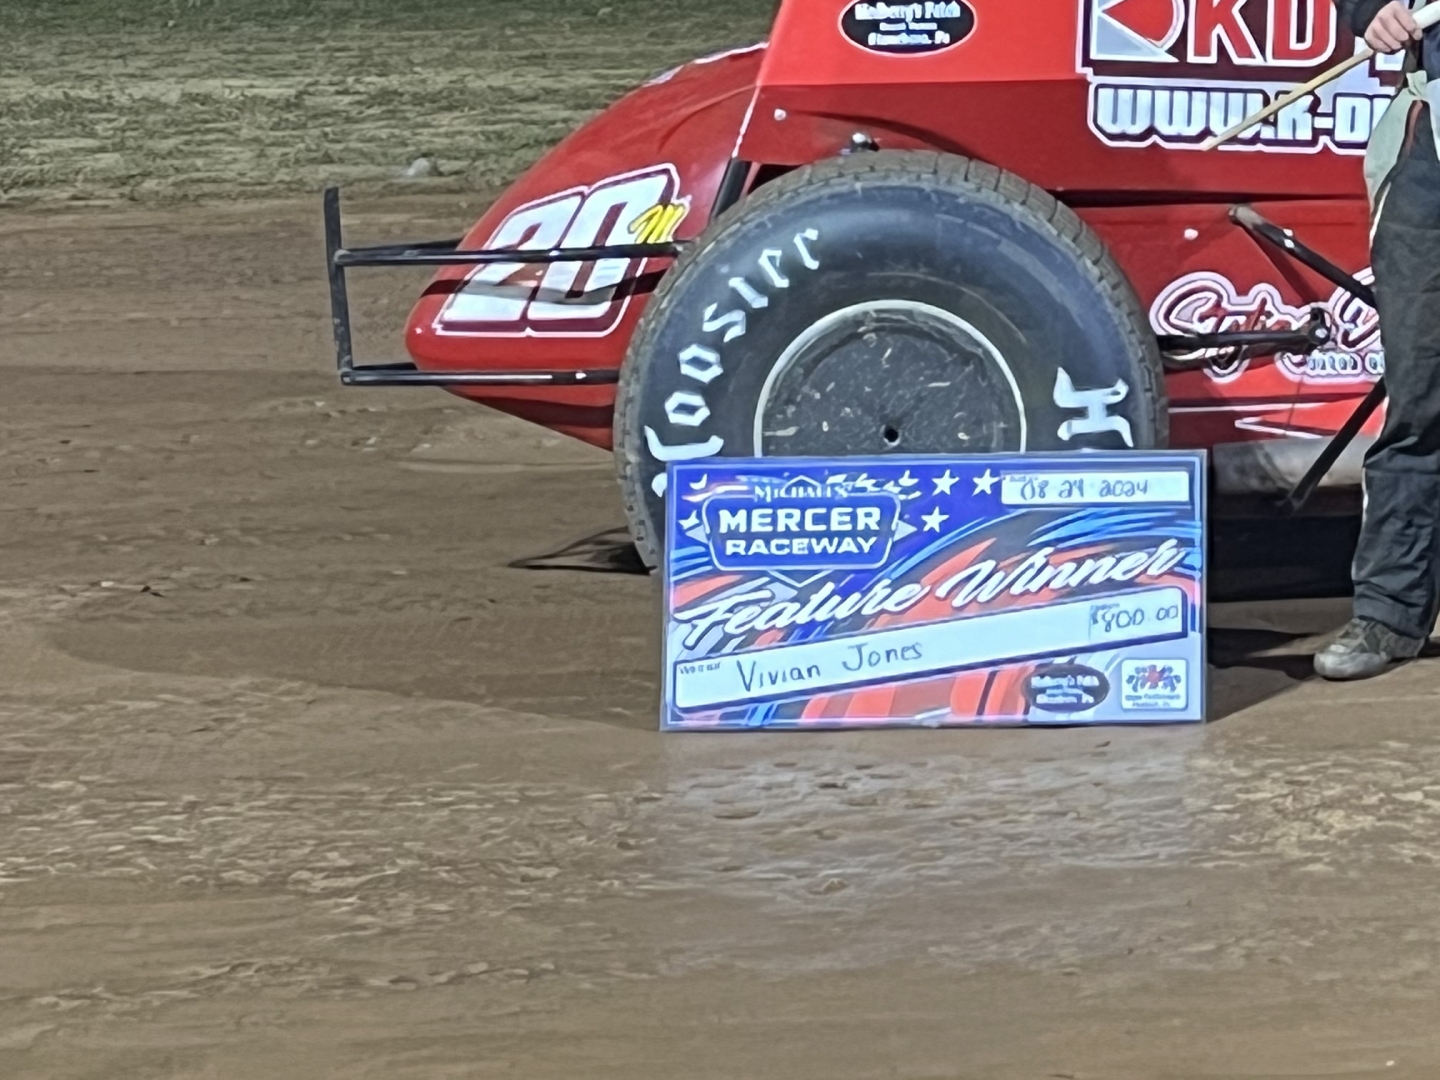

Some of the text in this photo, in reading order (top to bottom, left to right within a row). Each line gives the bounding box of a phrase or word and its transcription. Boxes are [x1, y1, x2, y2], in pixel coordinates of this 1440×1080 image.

[440, 170, 674, 328] 20
[718, 506, 882, 534] MERCER
[725, 536, 878, 556] RACEWAY
[675, 537, 1186, 651] Feature Winner
[735, 659, 822, 693] Vivian
[841, 641, 924, 673] Jones
